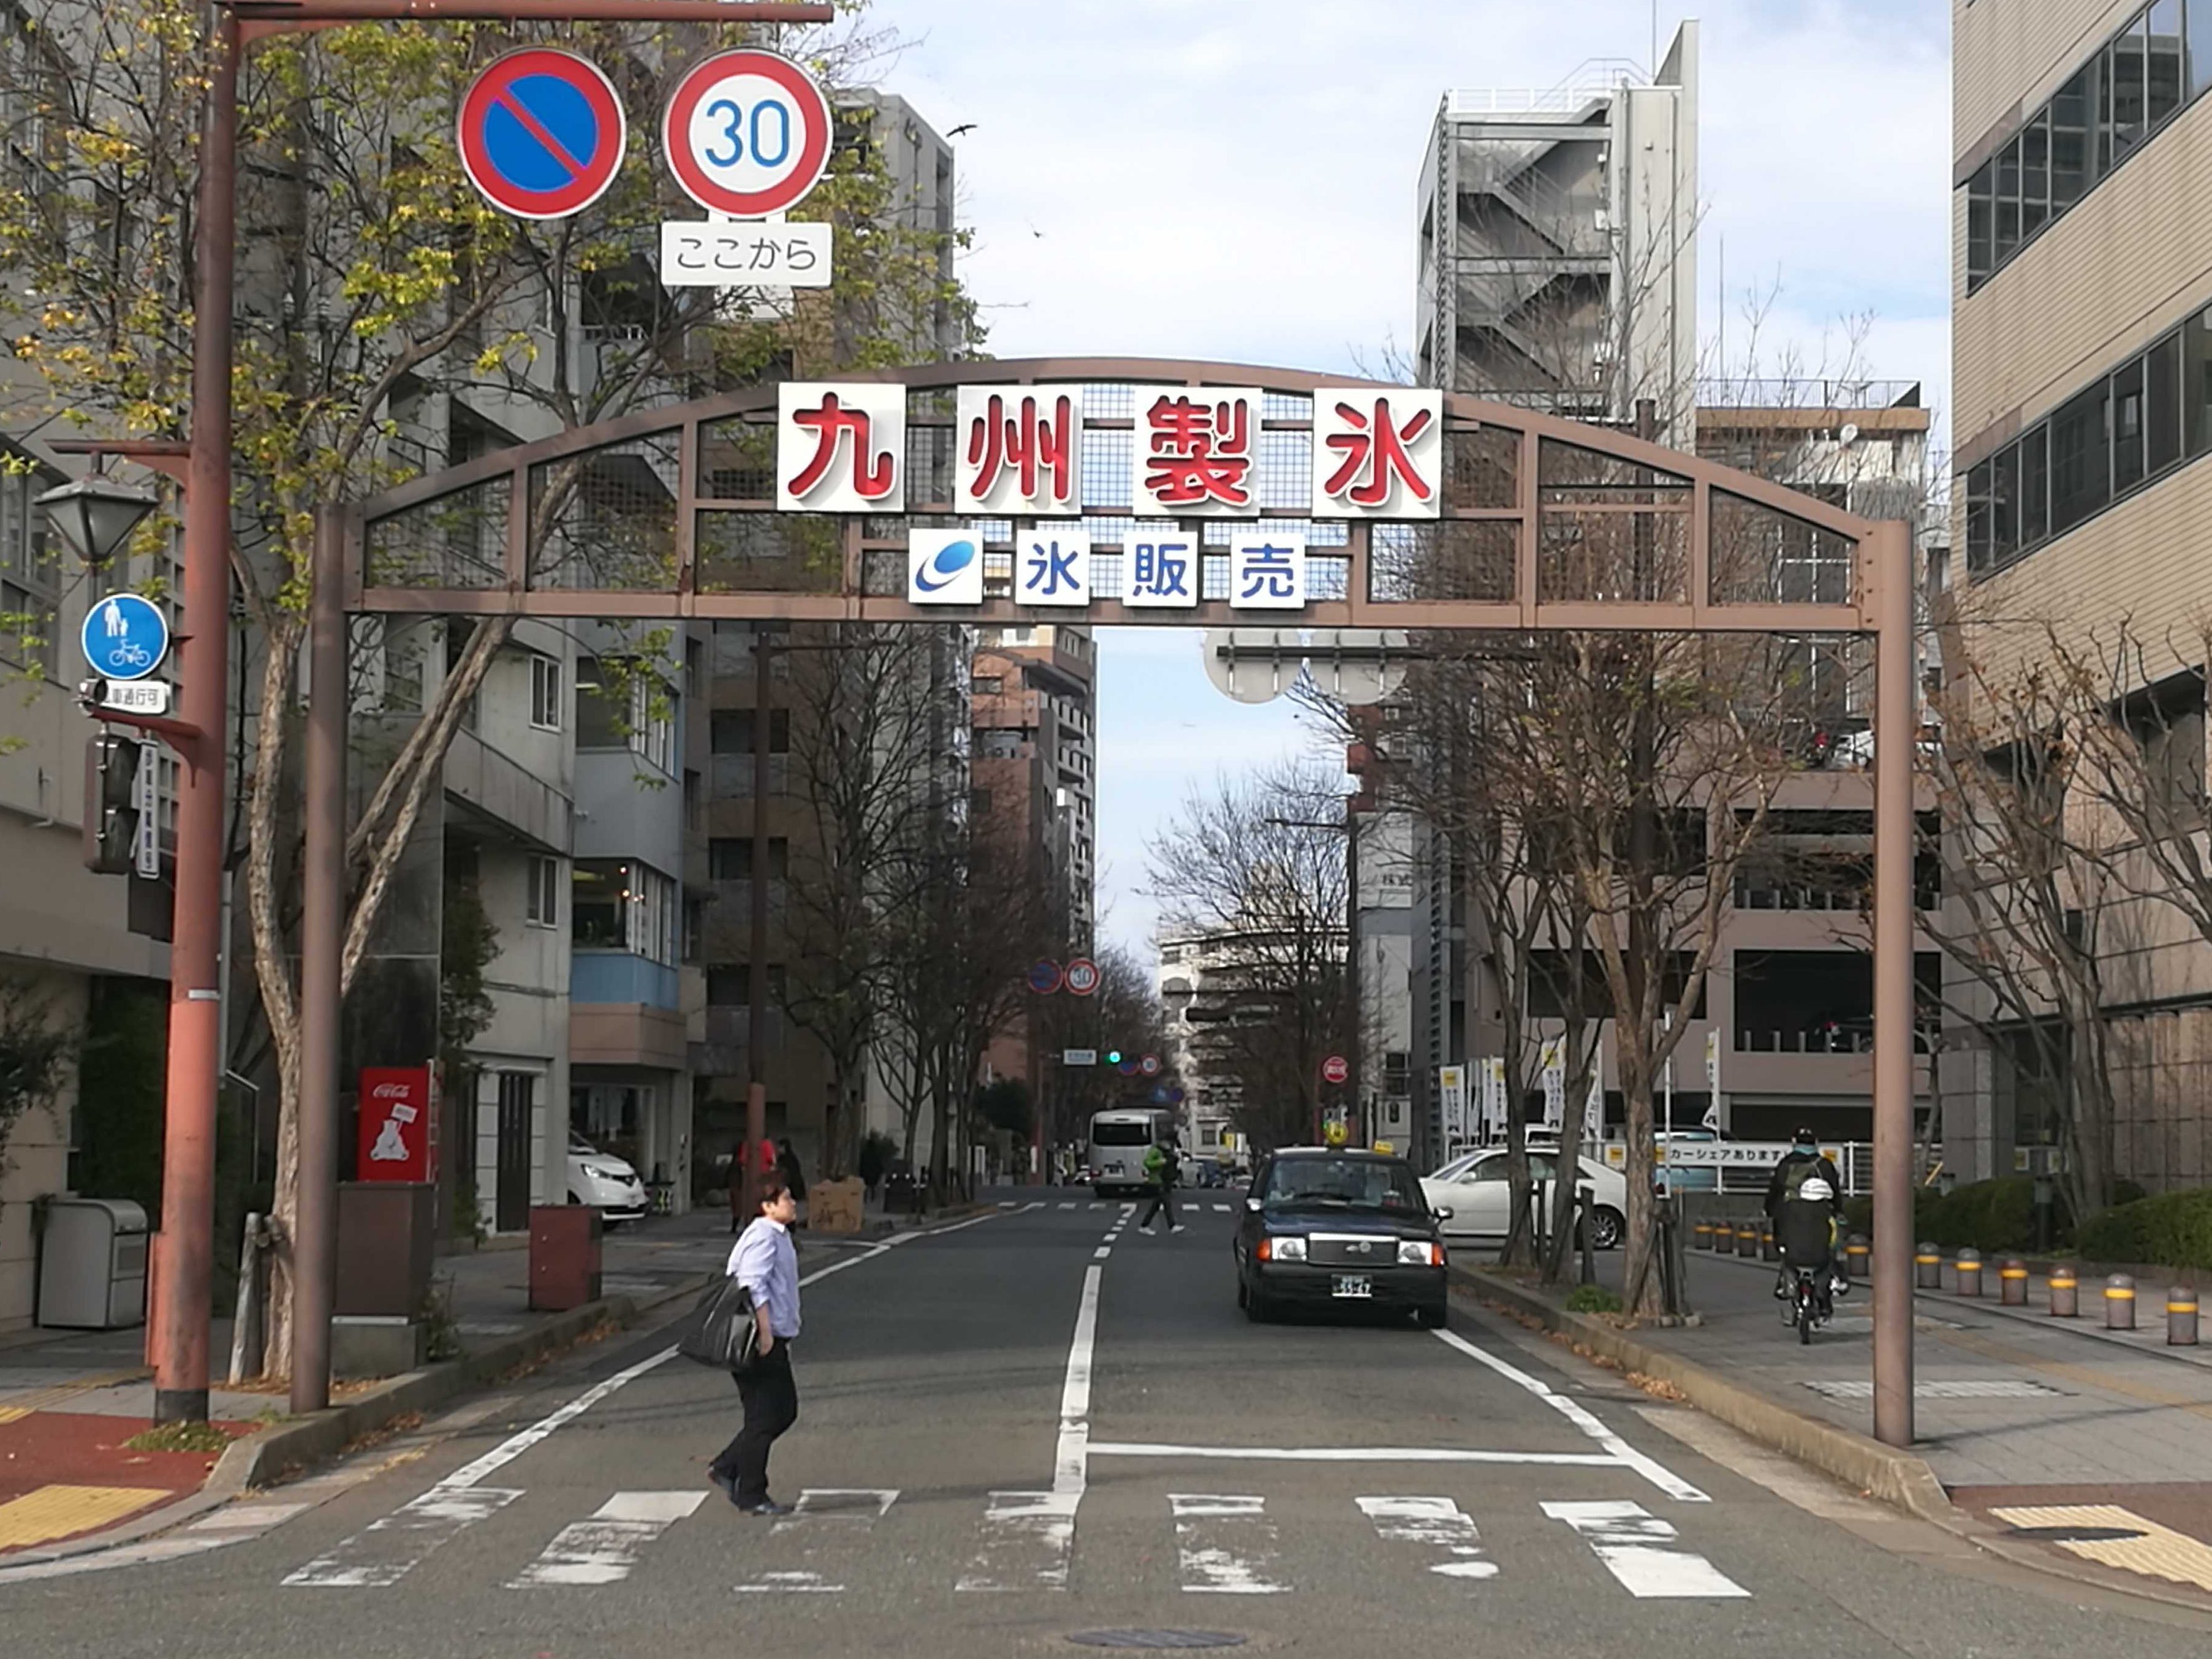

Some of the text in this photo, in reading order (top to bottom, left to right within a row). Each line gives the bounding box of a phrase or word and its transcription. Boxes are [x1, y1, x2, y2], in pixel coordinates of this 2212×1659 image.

[705, 99, 790, 168] 30
[676, 236, 817, 271] ここから
[787, 393, 1434, 506] 九州製氷
[1026, 540, 1297, 599] 氷販売
[1074, 967, 1093, 982] 30
